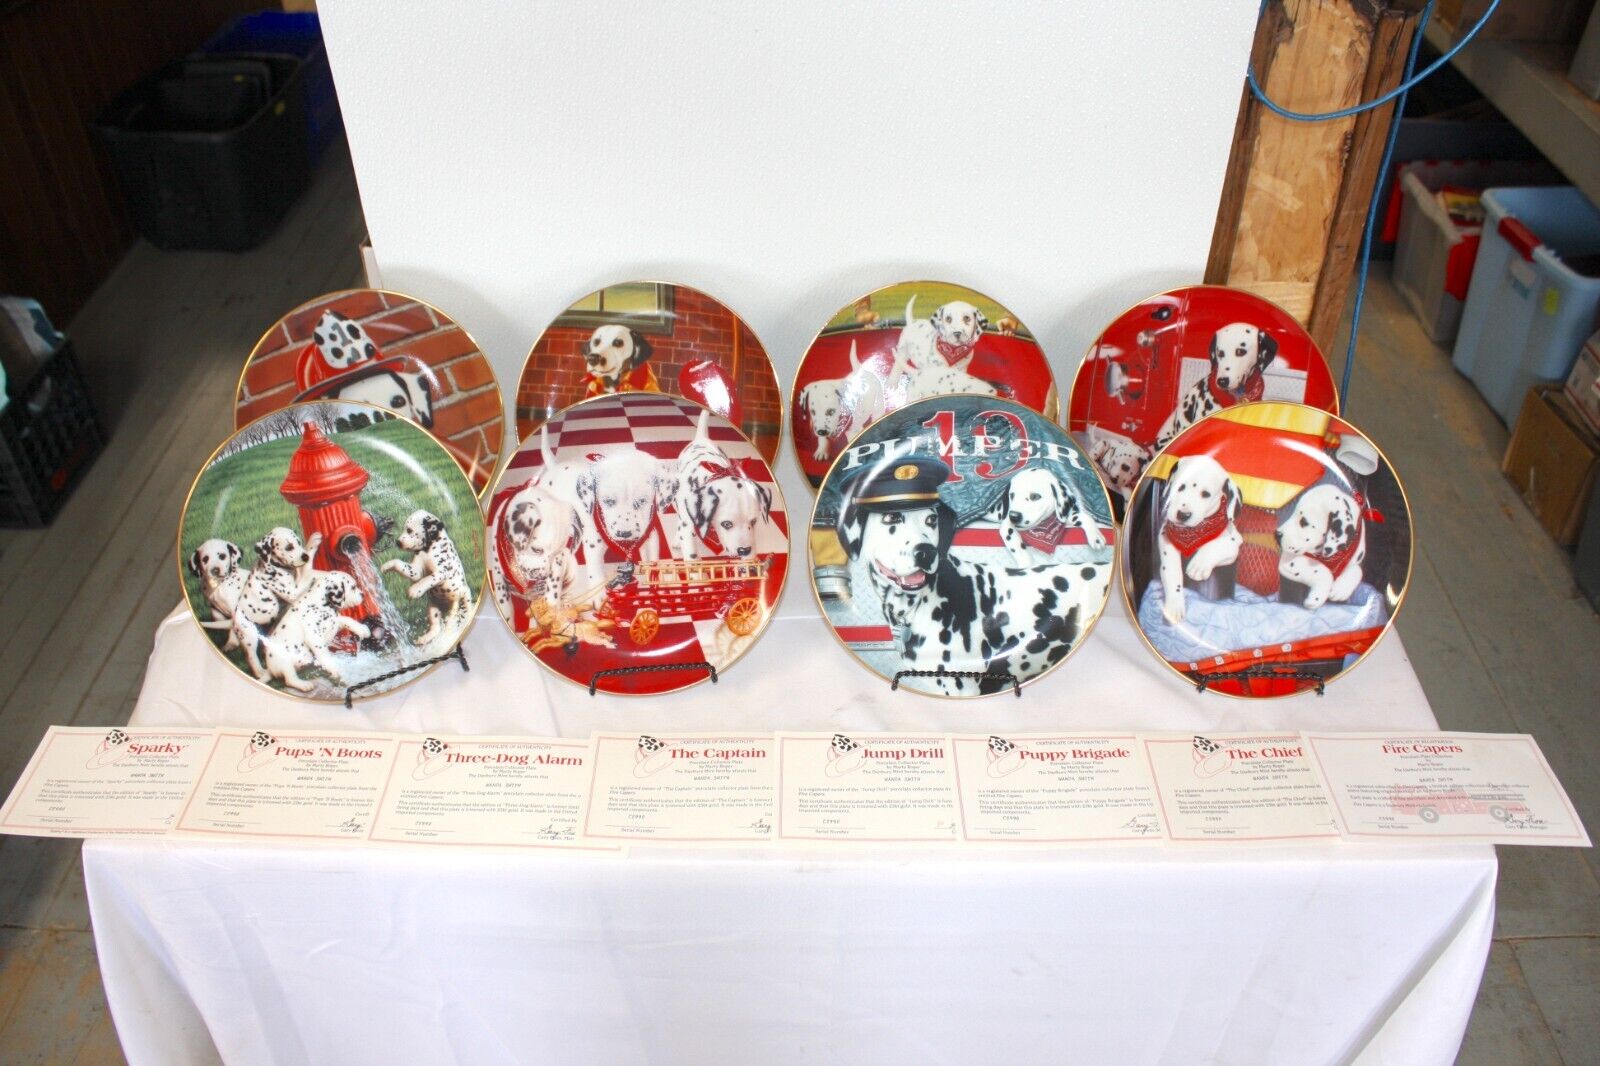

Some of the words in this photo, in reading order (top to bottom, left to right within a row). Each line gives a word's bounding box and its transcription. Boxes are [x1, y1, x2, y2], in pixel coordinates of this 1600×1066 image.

[842, 435, 1085, 472] PUMPER
[922, 410, 1029, 484] 19
[274, 746, 314, 759] Pups
[319, 747, 336, 757] 'N
[336, 748, 383, 759] Boots
[668, 748, 700, 759] The
[703, 747, 766, 760] Captain
[860, 748, 906, 761] Jump
[910, 748, 944, 759] Drill
[1020, 750, 1068, 762] Puppy
[1072, 748, 1131, 760] Brigade
[1225, 749, 1257, 759] The
[1260, 746, 1303, 758] Chief
[1382, 744, 1410, 754] Fire
[1412, 744, 1464, 755] Capers
[445, 752, 529, 766] Three-Dog
[533, 753, 583, 766] Alarm
